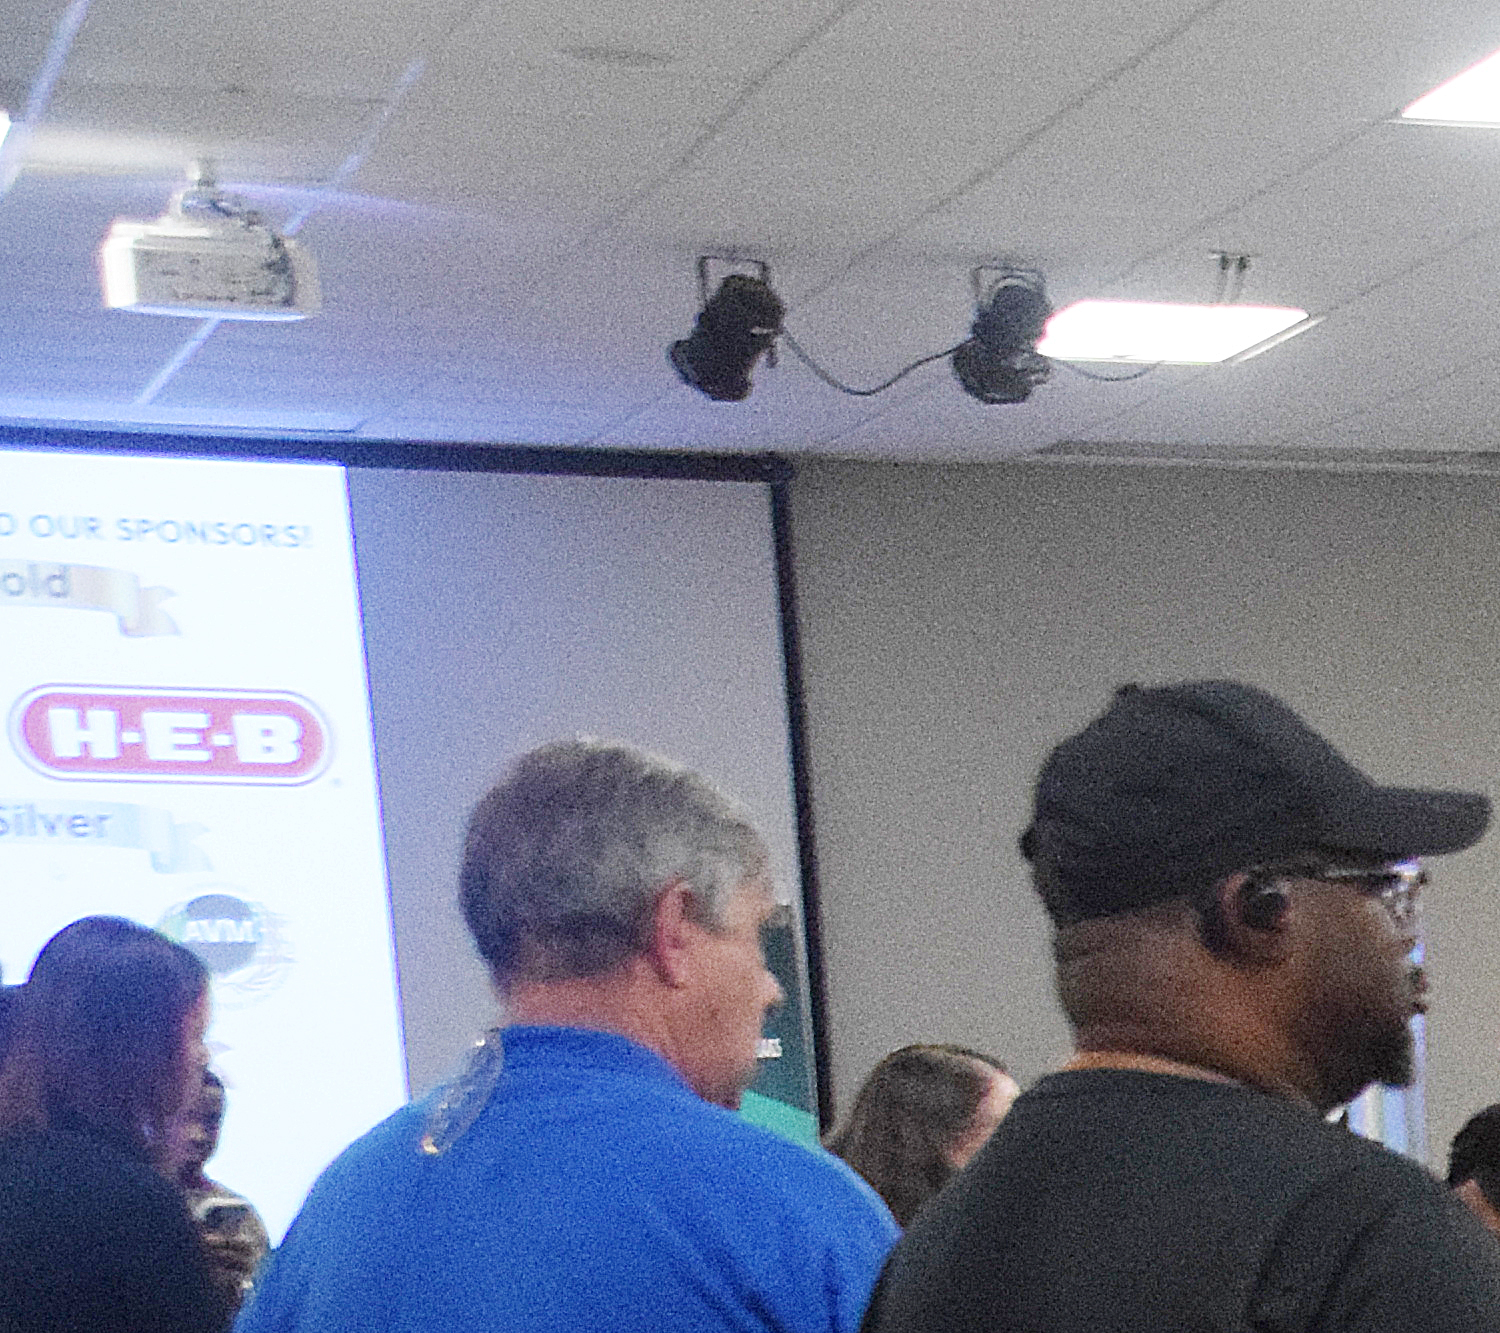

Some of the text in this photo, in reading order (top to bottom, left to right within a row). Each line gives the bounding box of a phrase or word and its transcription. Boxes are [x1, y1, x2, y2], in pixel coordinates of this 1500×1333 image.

[28, 513, 104, 540] OUR
[116, 517, 312, 548] SPONSORS!
[0, 563, 71, 599] old
